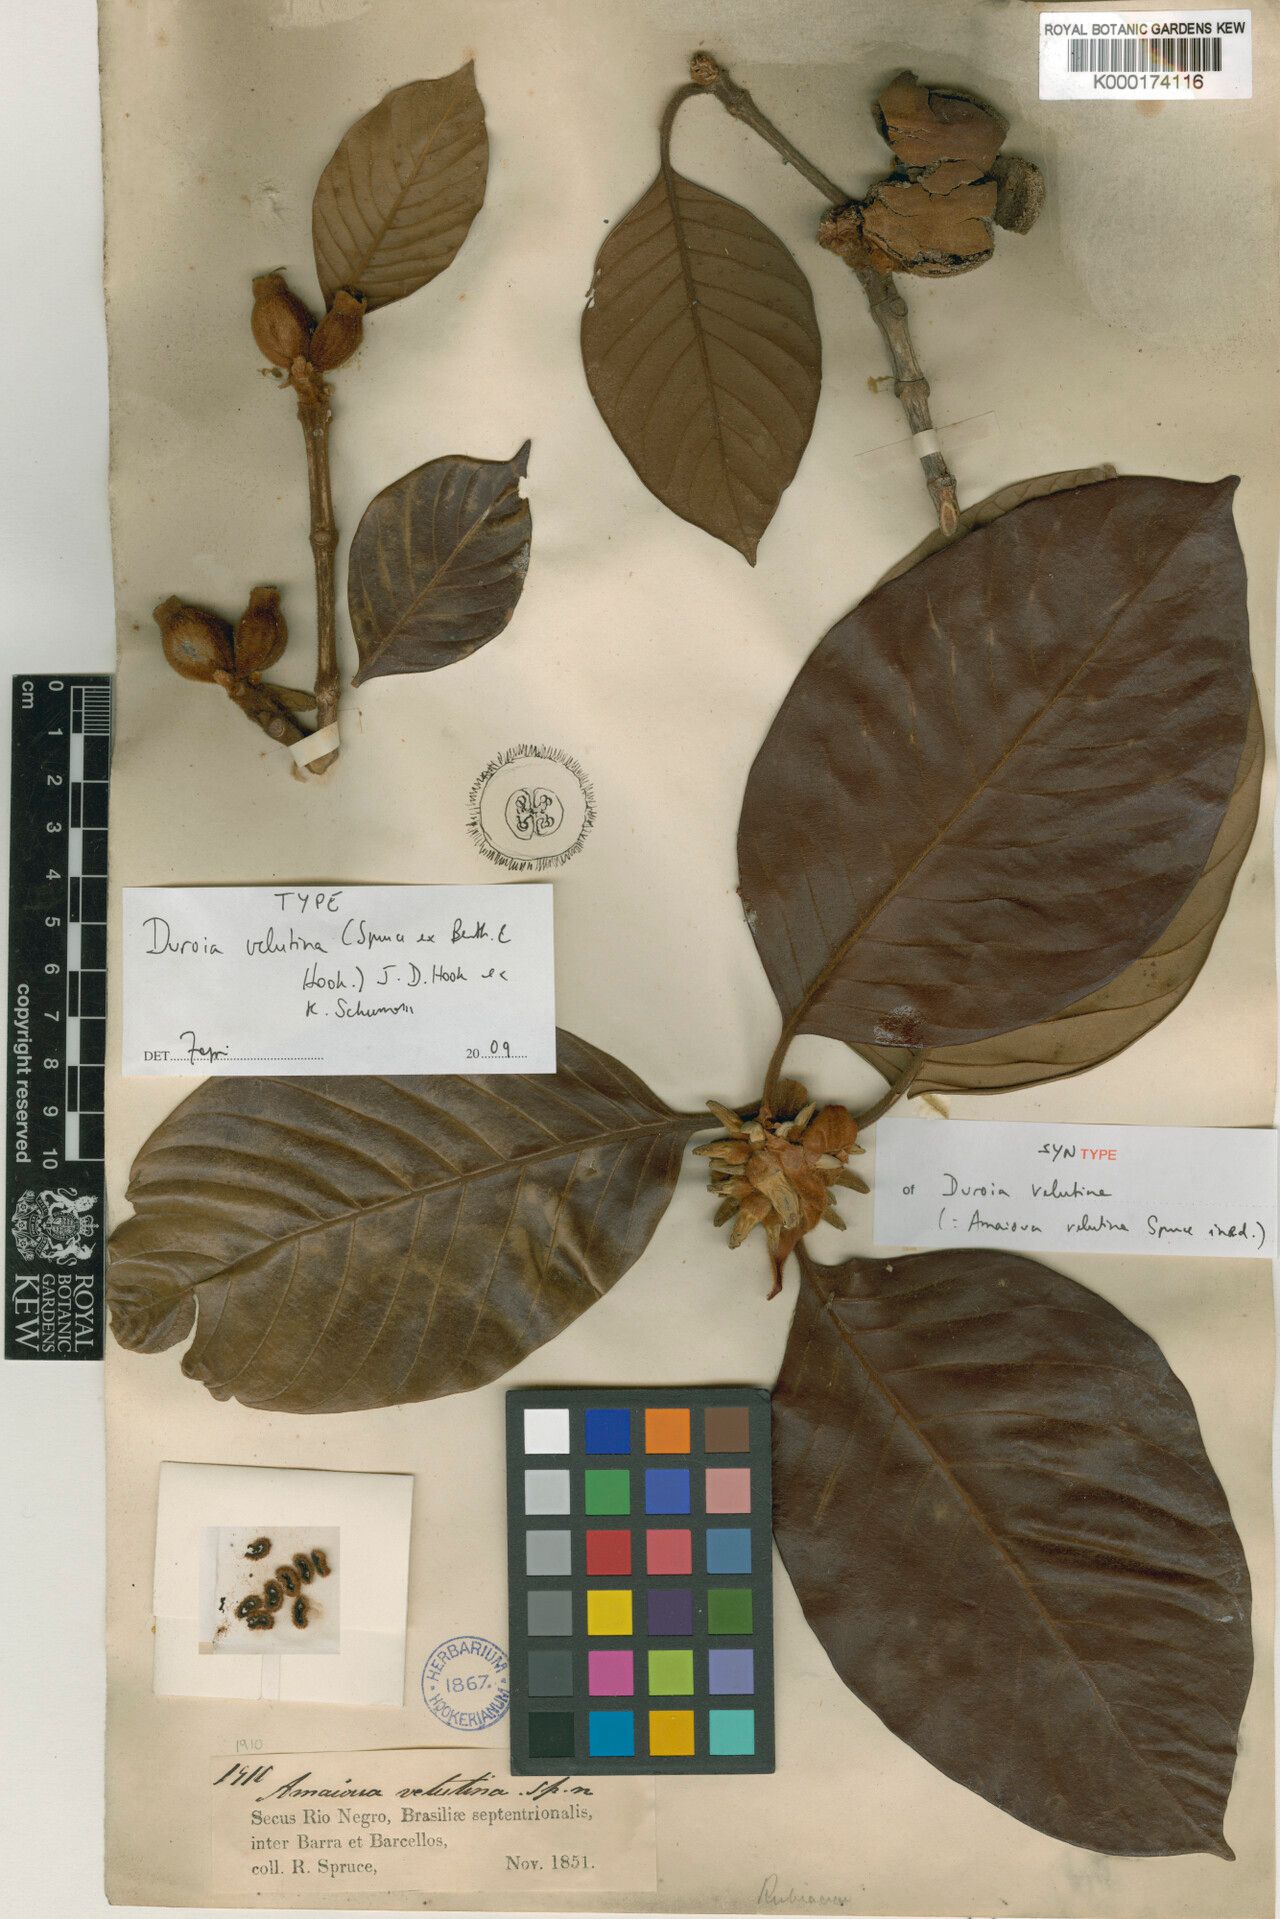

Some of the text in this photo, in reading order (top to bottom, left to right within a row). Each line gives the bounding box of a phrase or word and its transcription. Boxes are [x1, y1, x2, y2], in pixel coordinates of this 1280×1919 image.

[1044, 21, 1246, 36] ROYAL BOTANIC GARDENS KEW
[1093, 74, 1204, 90] K000174116
[21, 680, 34, 709] cm
[48, 680, 64, 692] 0
[48, 727, 63, 736] 1
[47, 774, 63, 786] 2
[46, 821, 62, 833] 3
[45, 868, 61, 880] 4
[274, 890, 344, 912] TYPE
[45, 916, 60, 927] 5
[142, 917, 224, 956] Duroia
[44, 963, 60, 974] 6
[44, 1010, 60, 1022] 7
[43, 1058, 59, 1069] 8
[13, 983, 33, 1163] copyright reserved
[43, 1105, 59, 1117] 9
[42, 1148, 58, 1170] 10
[902, 1182, 915, 1196] of
[942, 1173, 1010, 1198] Duroia
[12, 1273, 40, 1352] KEW
[41, 1273, 56, 1353] GARDENS
[57, 1274, 72, 1353] BOTANIC
[73, 1274, 94, 1353] ROYAL
[426, 1641, 508, 1682] HERBARIUM
[428, 1687, 510, 1727] HOOKERIANUM
[236, 1738, 264, 1753] 1910
[251, 1804, 593, 1829] Secus Rio Negro, Brasiliæ septentrionalis,
[251, 1832, 448, 1850] inter Barra et Barcellos,
[251, 1858, 378, 1879] coll. R. Spruce,
[505, 1854, 595, 1871] Nov. 1851.
